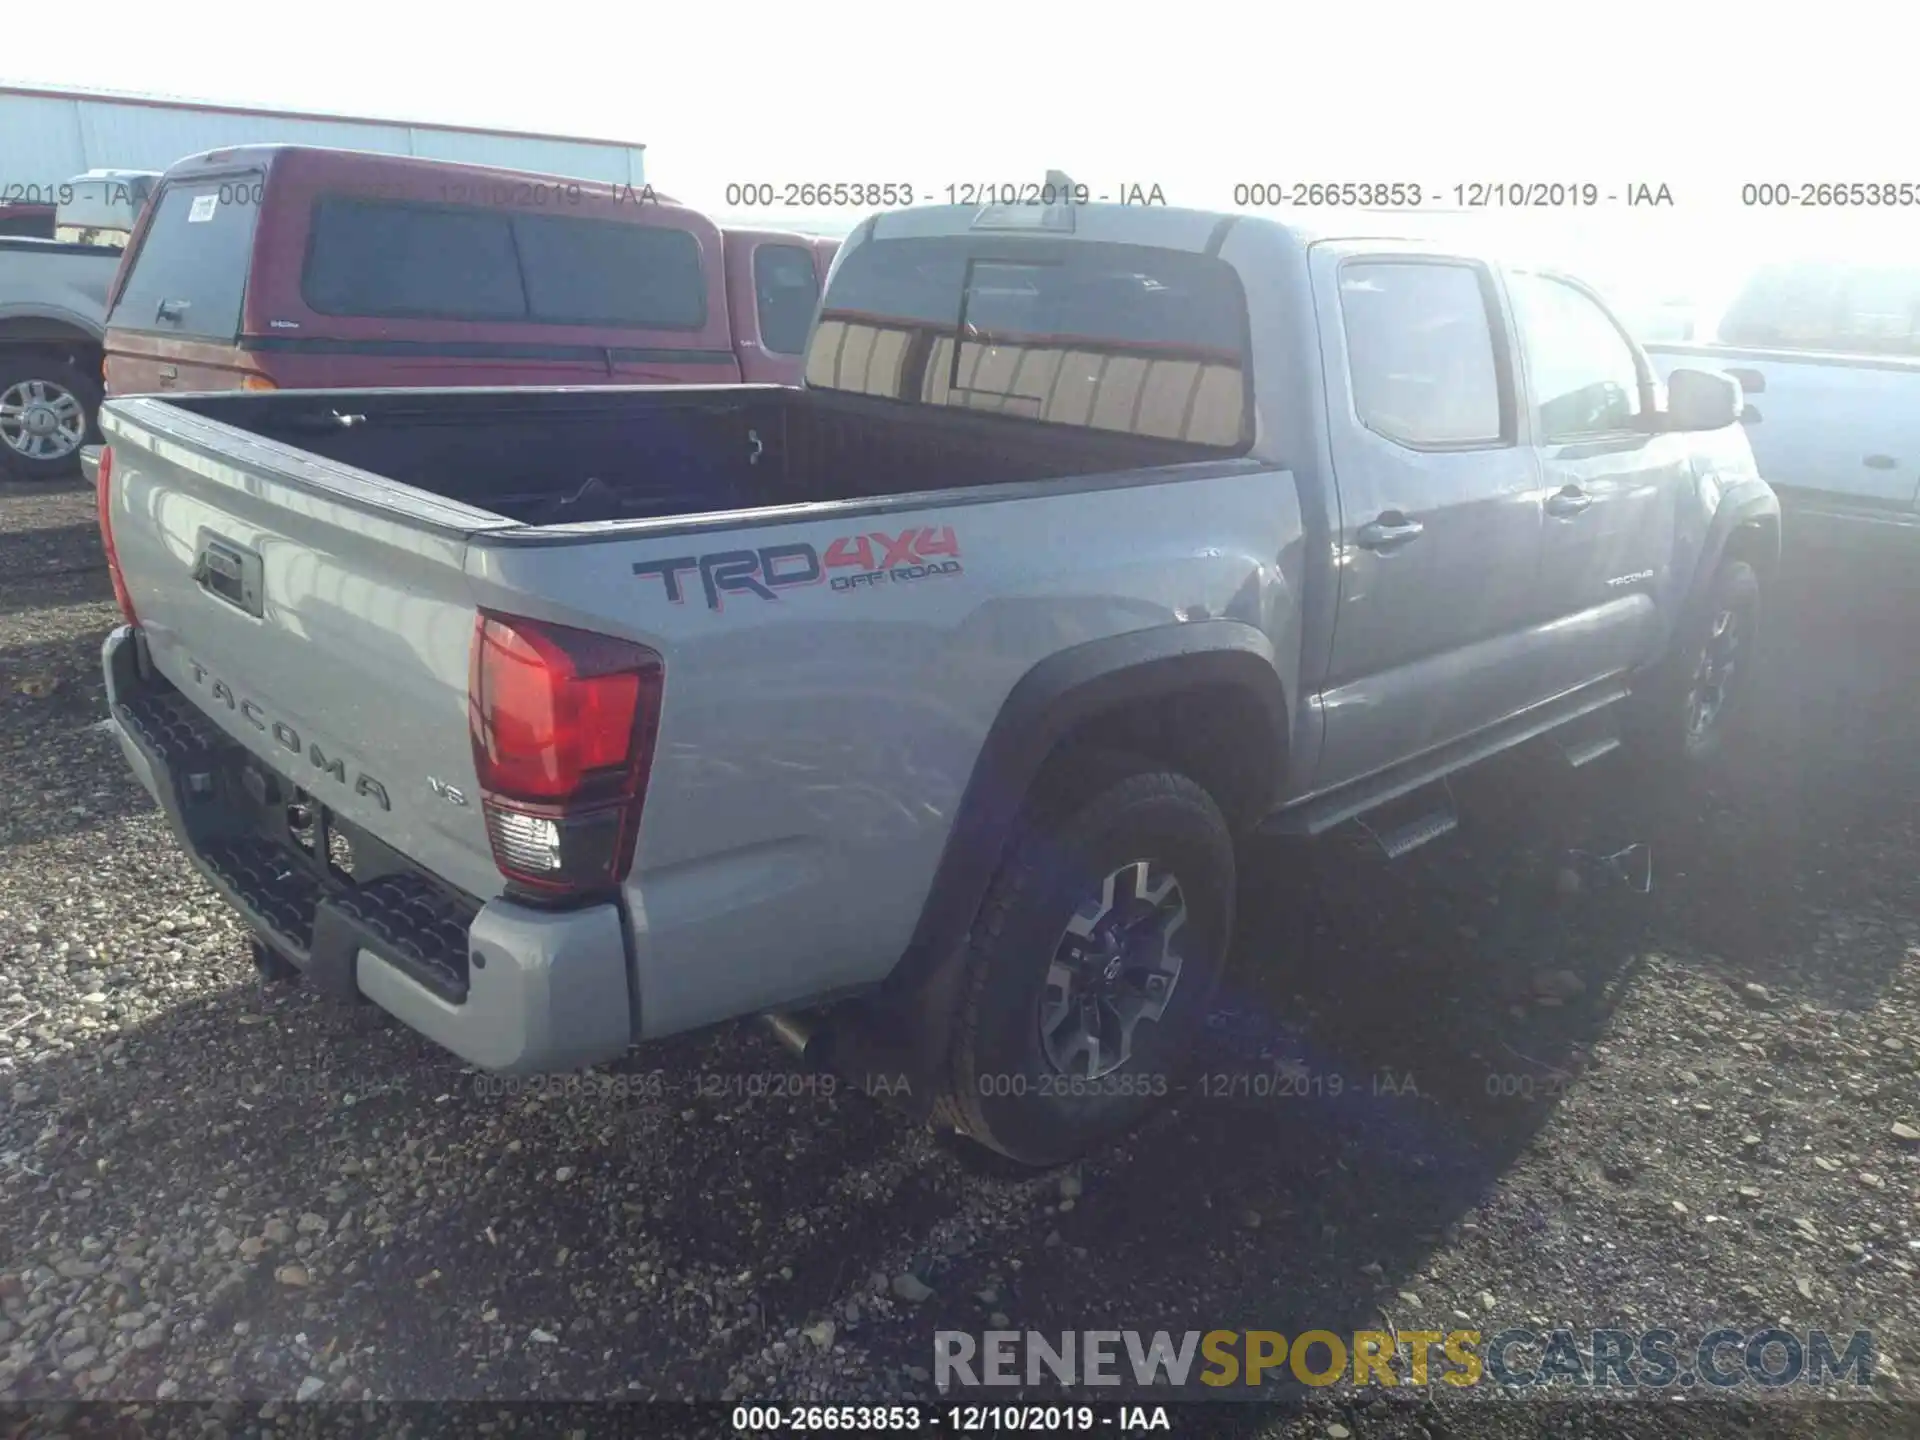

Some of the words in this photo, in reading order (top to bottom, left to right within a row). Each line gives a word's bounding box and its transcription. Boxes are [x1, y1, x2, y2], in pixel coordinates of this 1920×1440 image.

[632, 542, 827, 613] TRD
[830, 571, 884, 592] OFF
[890, 561, 962, 582] ROAD
[189, 657, 391, 812] TACOMA
[427, 775, 468, 806] V6
